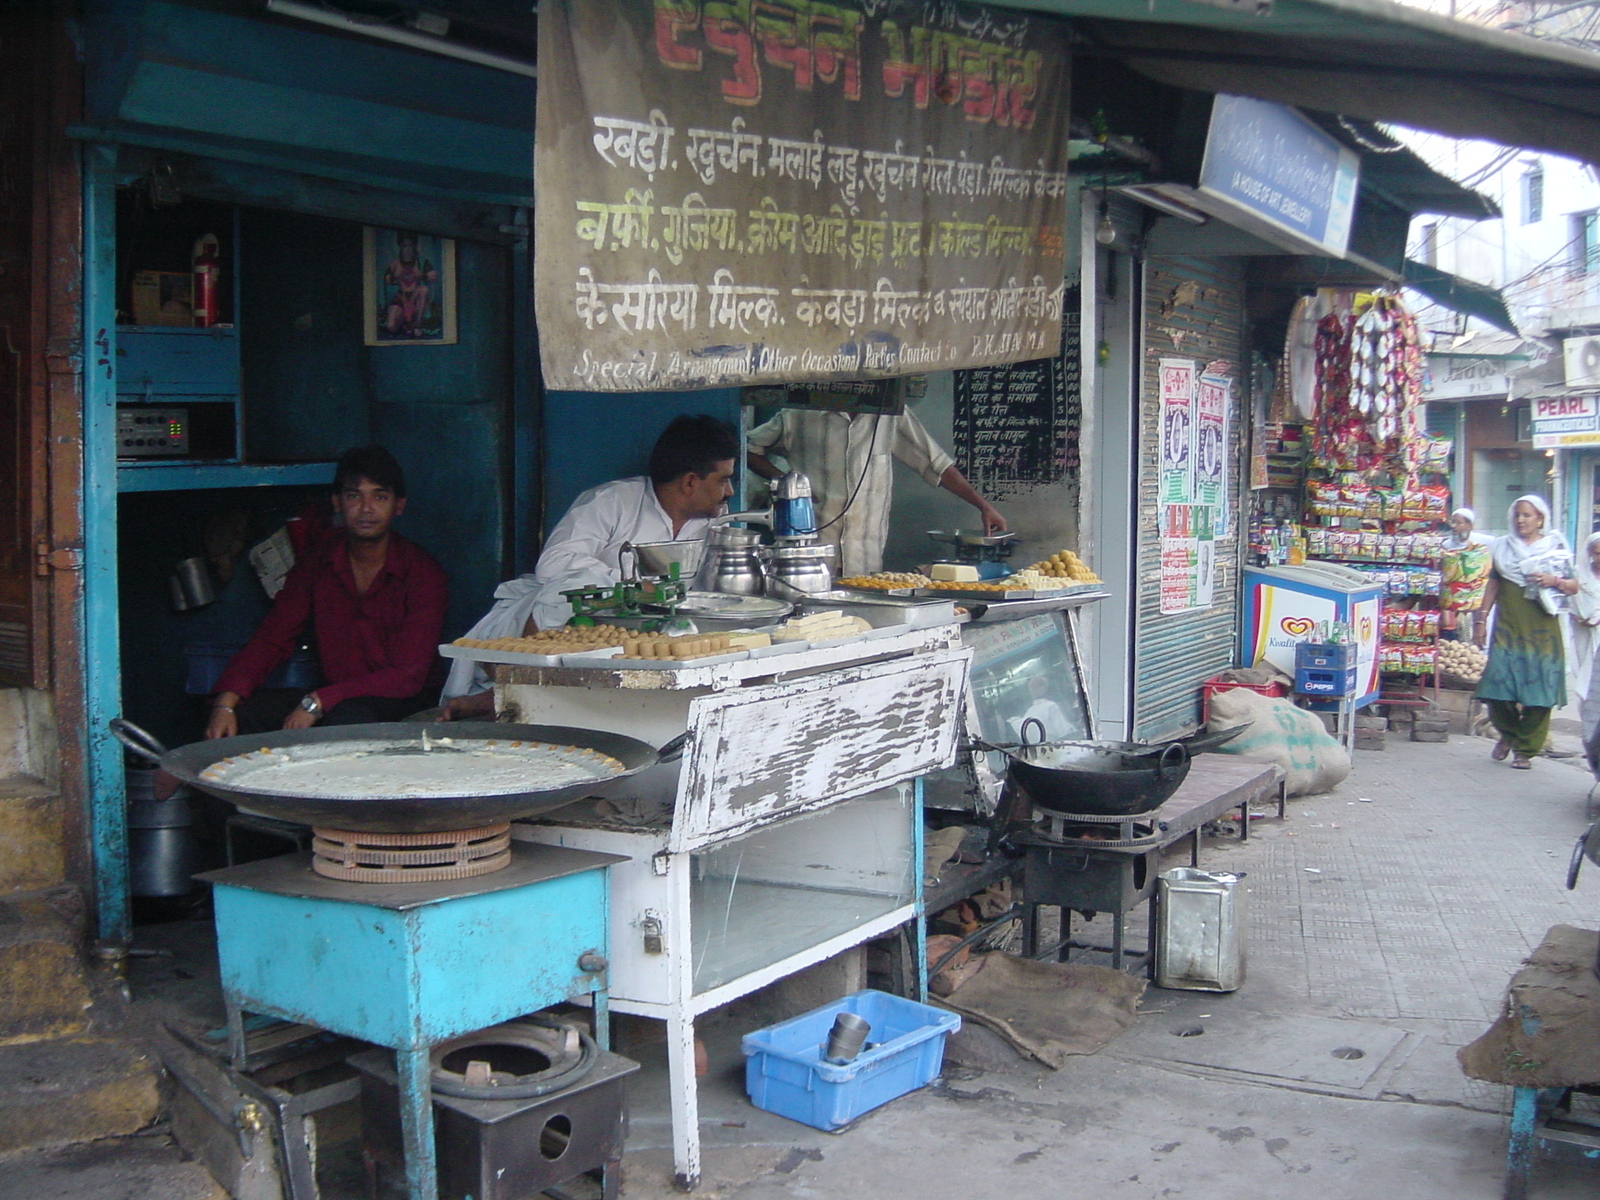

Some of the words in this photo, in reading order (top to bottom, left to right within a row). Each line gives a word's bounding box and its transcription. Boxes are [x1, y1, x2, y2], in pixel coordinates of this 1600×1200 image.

[573, 349, 657, 384] Special
[760, 346, 797, 374] Other
[801, 343, 861, 374] Occasional
[899, 333, 942, 365] Contact
[1537, 398, 1588, 417] PEARL
[1269, 637, 1297, 652] Kwalit
